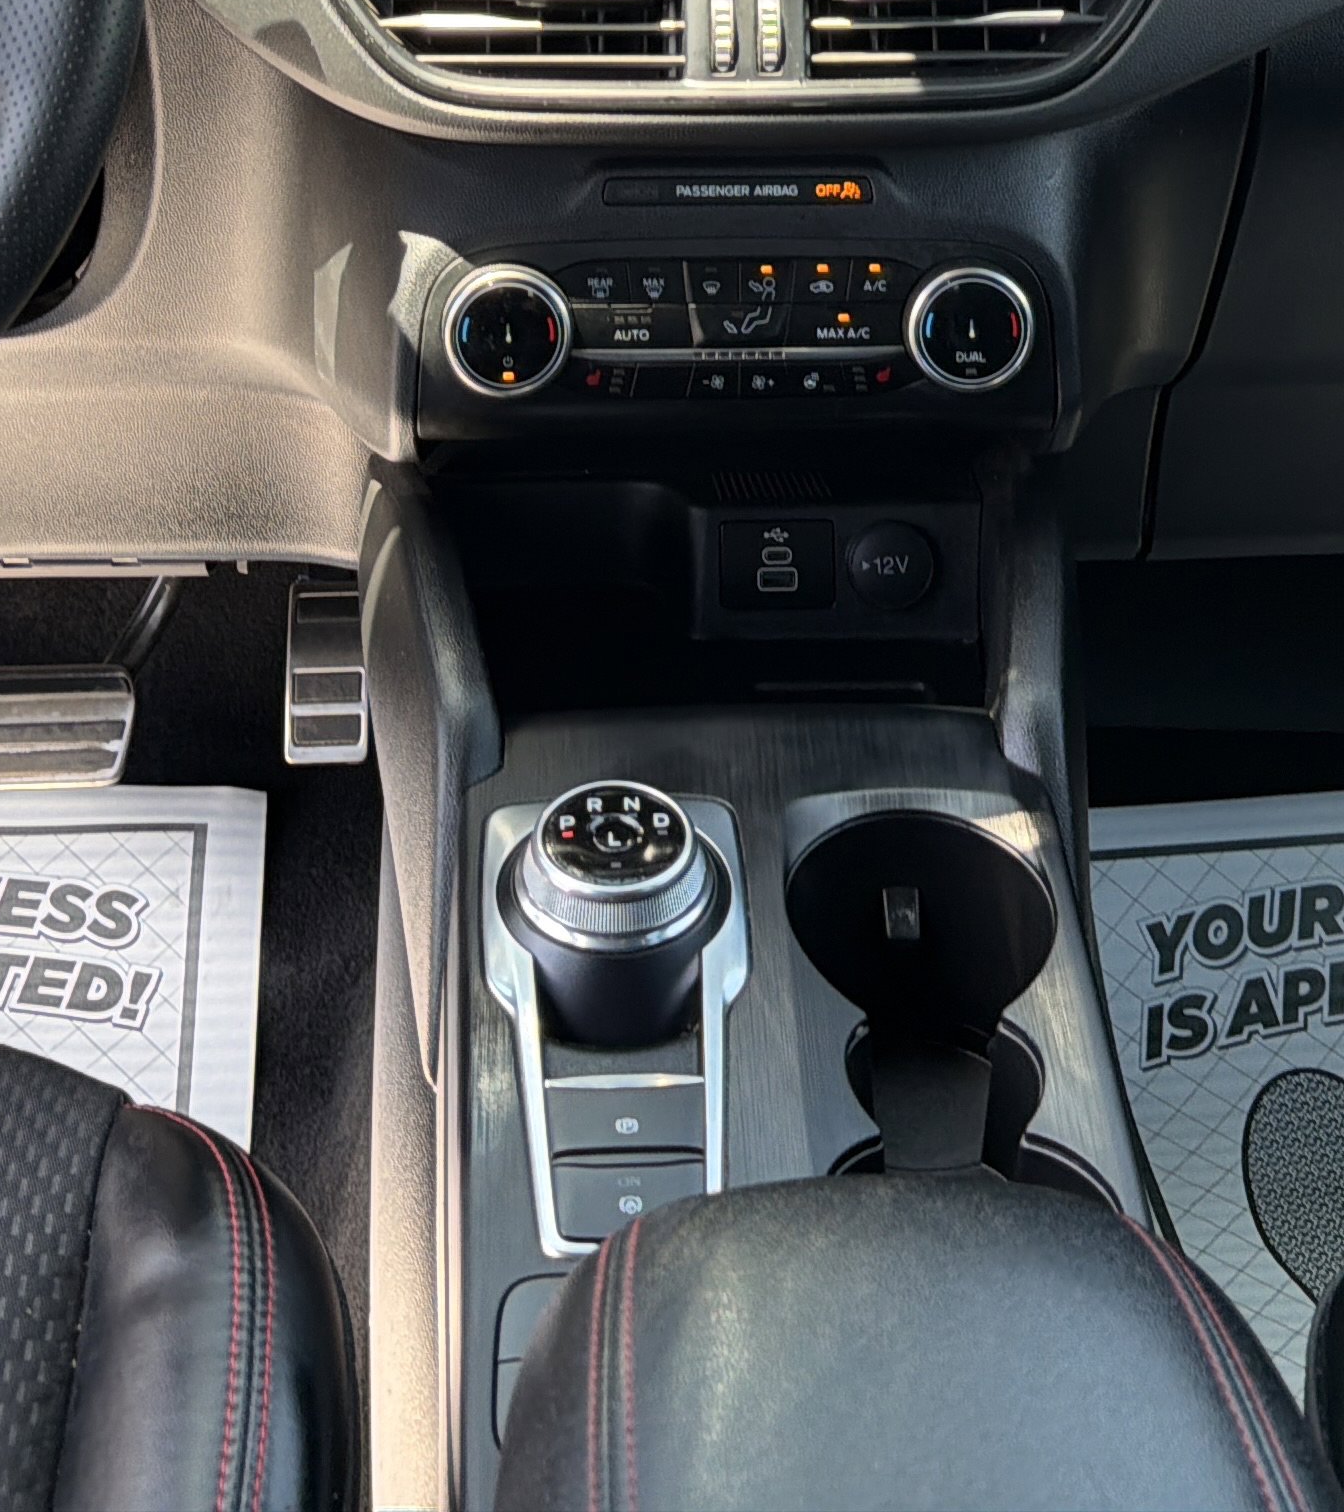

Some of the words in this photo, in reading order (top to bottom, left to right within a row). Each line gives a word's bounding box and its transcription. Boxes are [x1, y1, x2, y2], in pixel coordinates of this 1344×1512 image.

[676, 184, 750, 198] PASSENGER
[753, 184, 799, 197] AIRBAG
[815, 183, 841, 198] OFF
[587, 277, 614, 287] REAR
[642, 277, 665, 287] MAX
[863, 279, 887, 293] A/C
[614, 328, 650, 341] AUTO
[816, 327, 844, 339] MAX
[847, 326, 871, 340] A/C
[955, 351, 986, 363] DUAL
[873, 555, 909, 575] 12V
[586, 797, 603, 812] R
[623, 796, 641, 811] N
[559, 815, 576, 830] P
[652, 812, 670, 828] D
[607, 831, 622, 847] L
[1143, 993, 1214, 1063] IS
